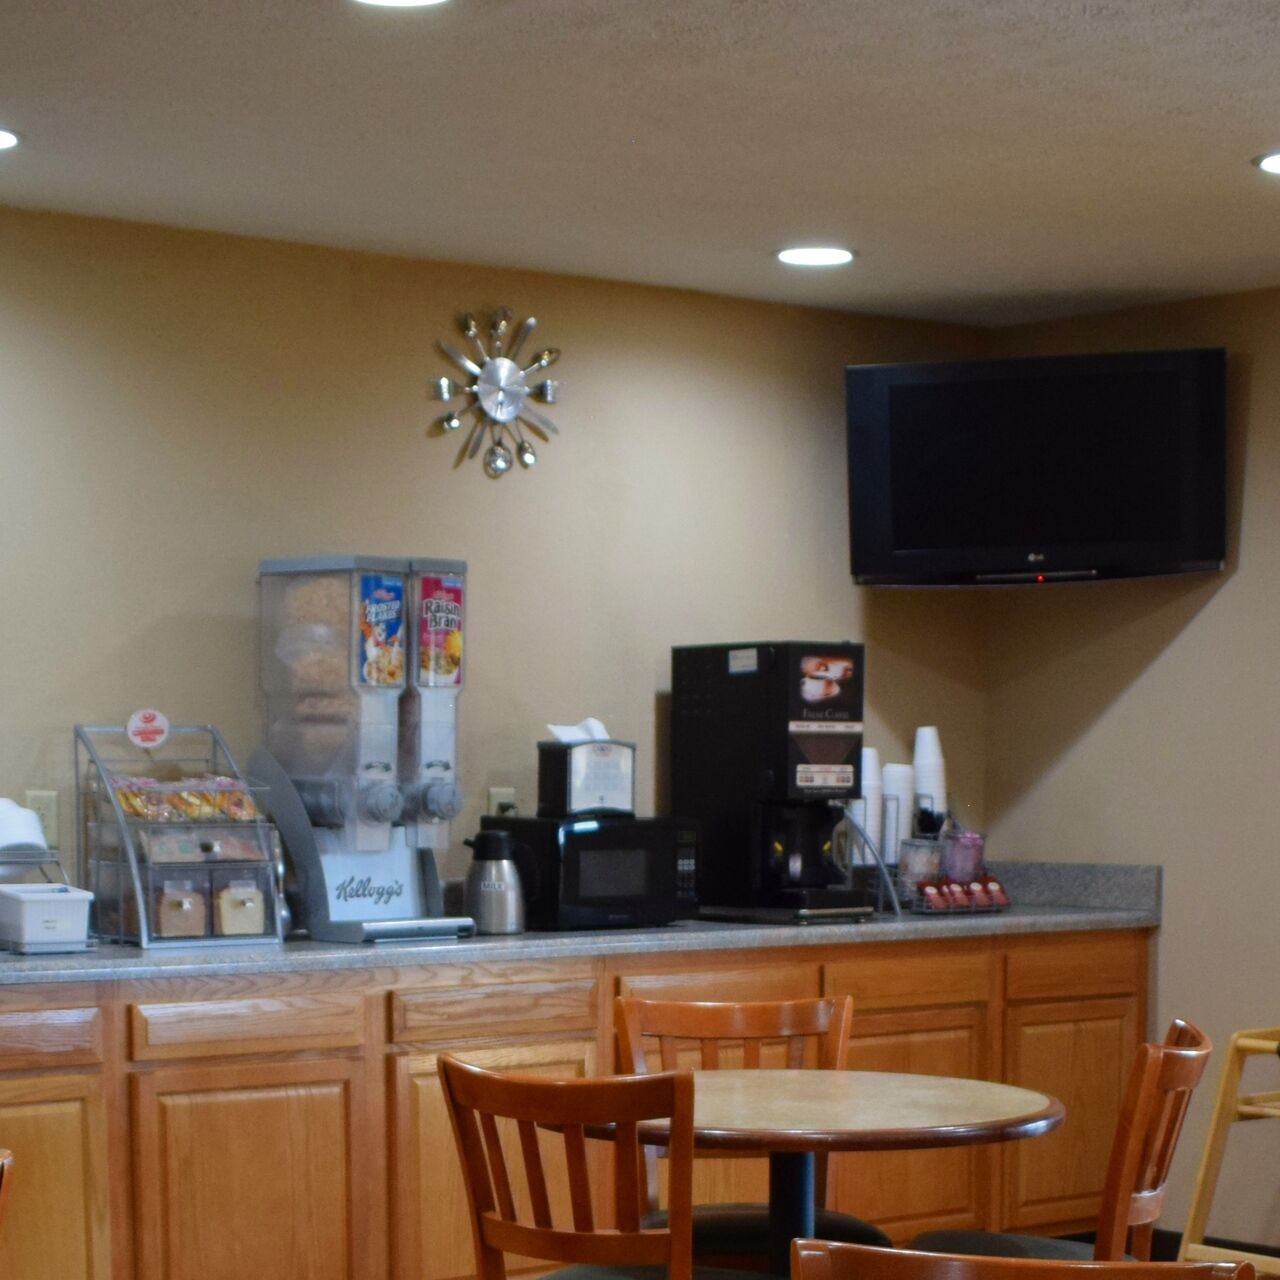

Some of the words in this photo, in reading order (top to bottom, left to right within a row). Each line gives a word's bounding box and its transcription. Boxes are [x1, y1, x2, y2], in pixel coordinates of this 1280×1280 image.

[424, 599, 461, 617] Raisin
[429, 614, 458, 629] Bran
[335, 875, 405, 905] Kellogg's
